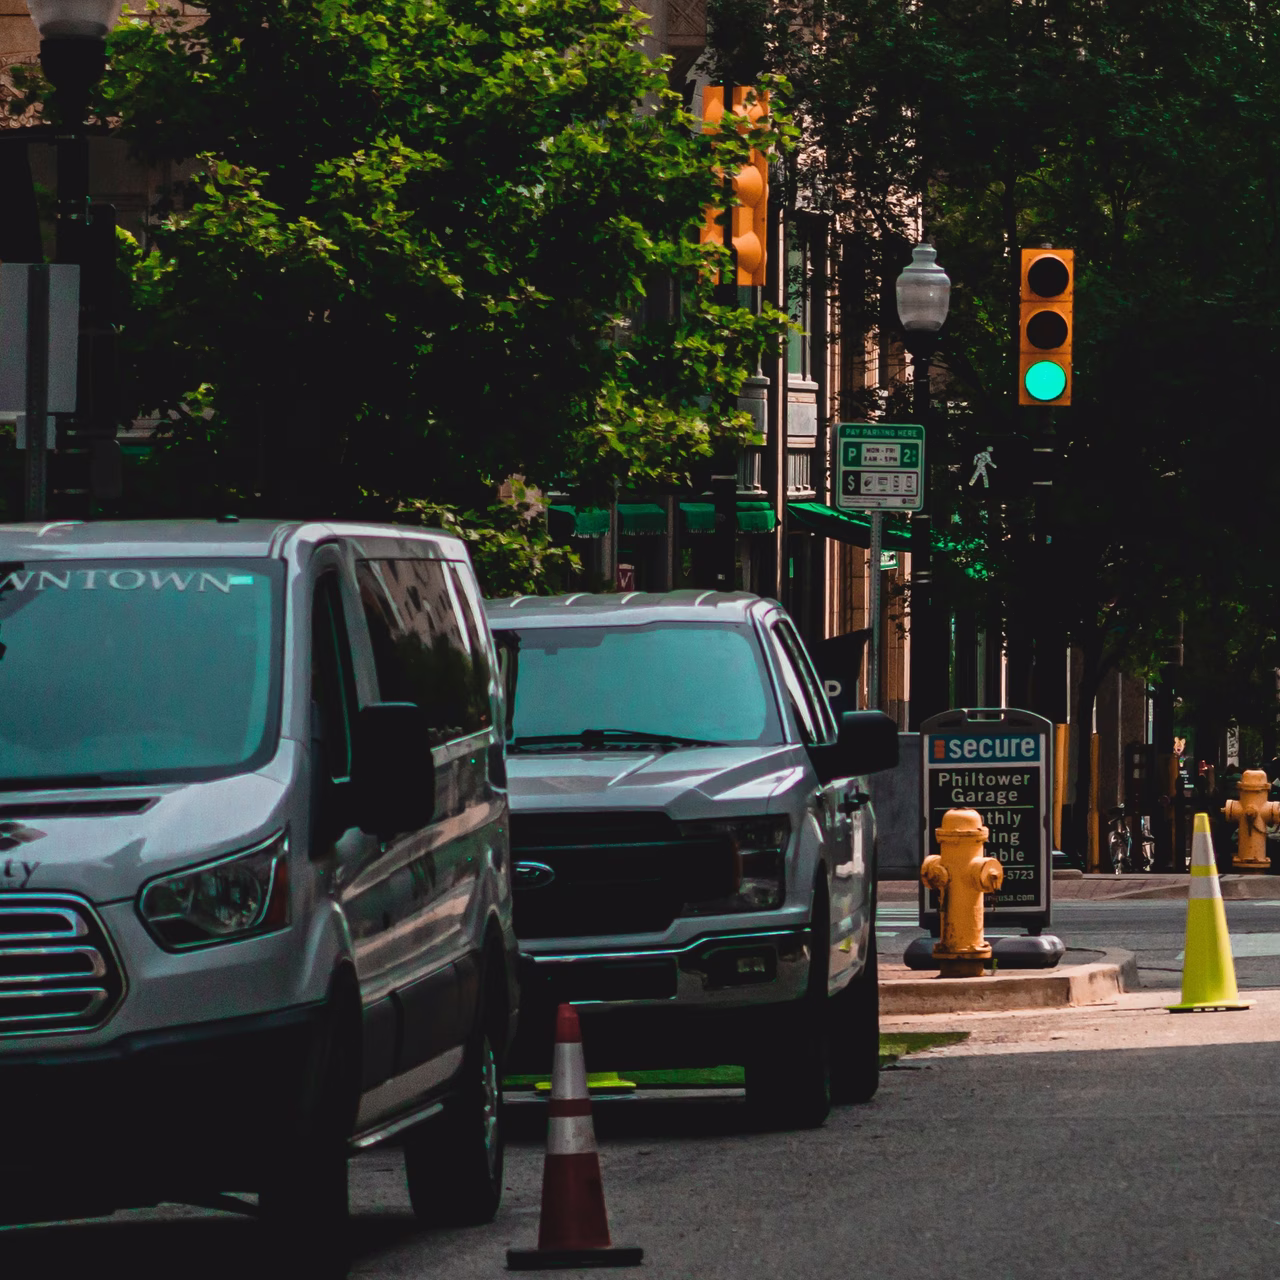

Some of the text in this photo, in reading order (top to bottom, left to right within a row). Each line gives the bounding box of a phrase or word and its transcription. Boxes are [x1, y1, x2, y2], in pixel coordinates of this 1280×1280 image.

[845, 428, 860, 436] PAY
[897, 429, 918, 438] HERE
[848, 448, 856, 461] P
[903, 449, 911, 463] 2
[949, 737, 1035, 759] secure
[938, 772, 1030, 787] Philtower
[951, 788, 1018, 805] Garage
[982, 810, 1021, 828] thly
[987, 829, 1020, 846] ing
